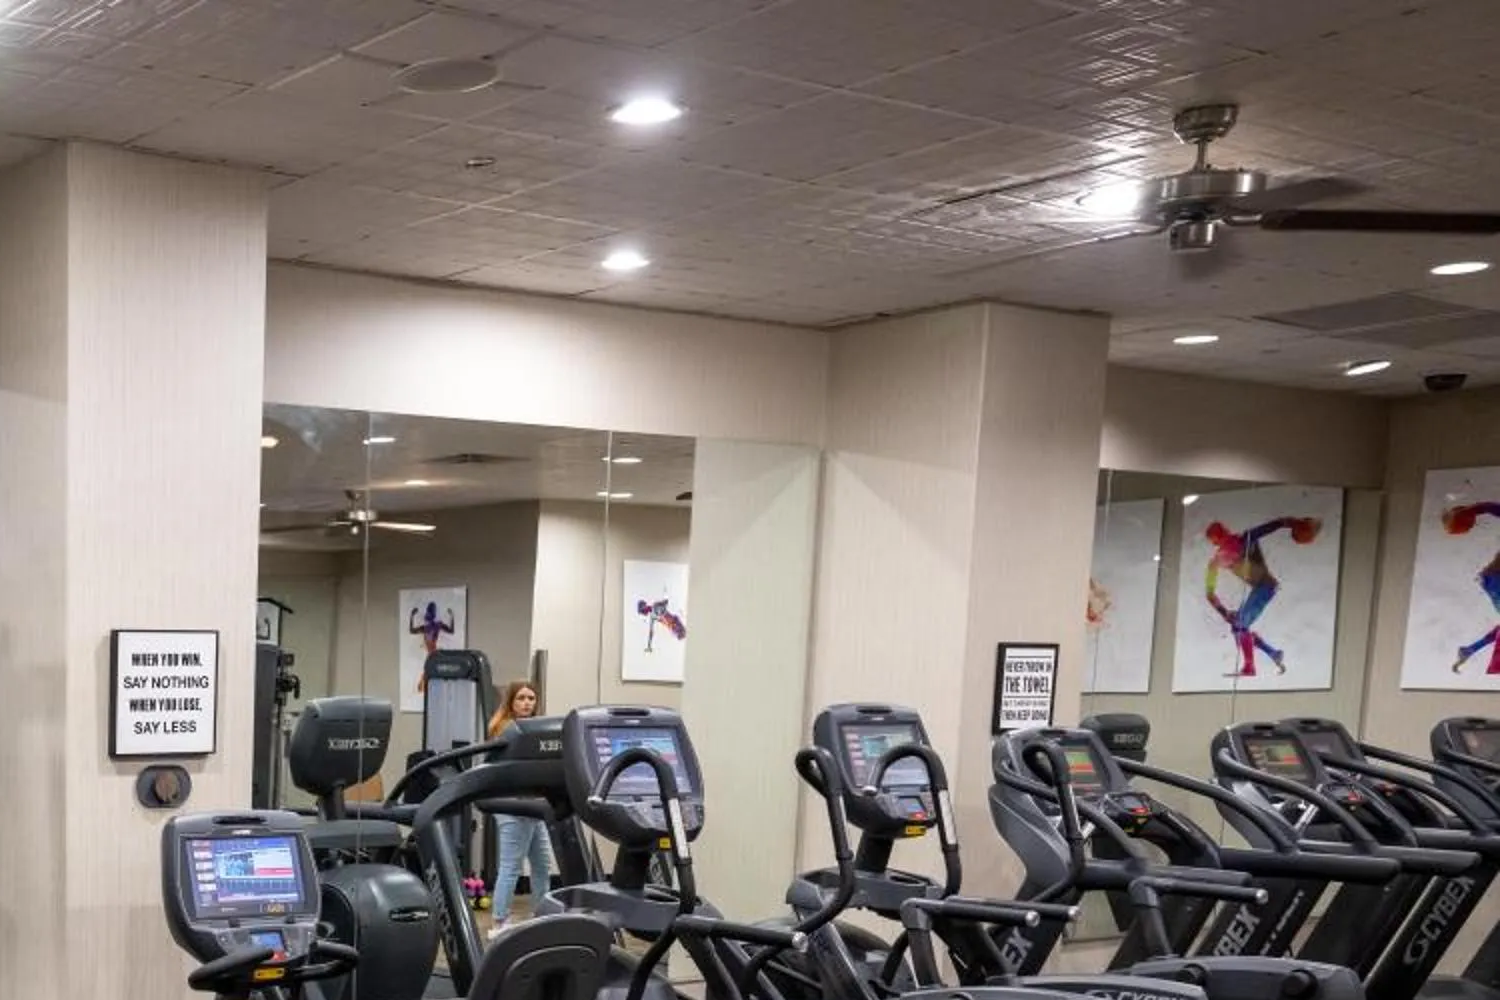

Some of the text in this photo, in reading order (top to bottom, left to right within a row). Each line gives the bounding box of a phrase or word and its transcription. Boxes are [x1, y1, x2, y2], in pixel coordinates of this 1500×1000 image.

[131, 653, 159, 667] WHEN
[161, 653, 179, 667] YOU
[123, 675, 209, 689] SAY NOTHING
[1005, 676, 1049, 693] THE TOWEL
[129, 699, 157, 712] WHEN
[158, 698, 177, 712] YOU
[133, 720, 197, 735] SAY LESS
[1421, 877, 1476, 941] CYBEX
[1213, 904, 1261, 957] BEX
